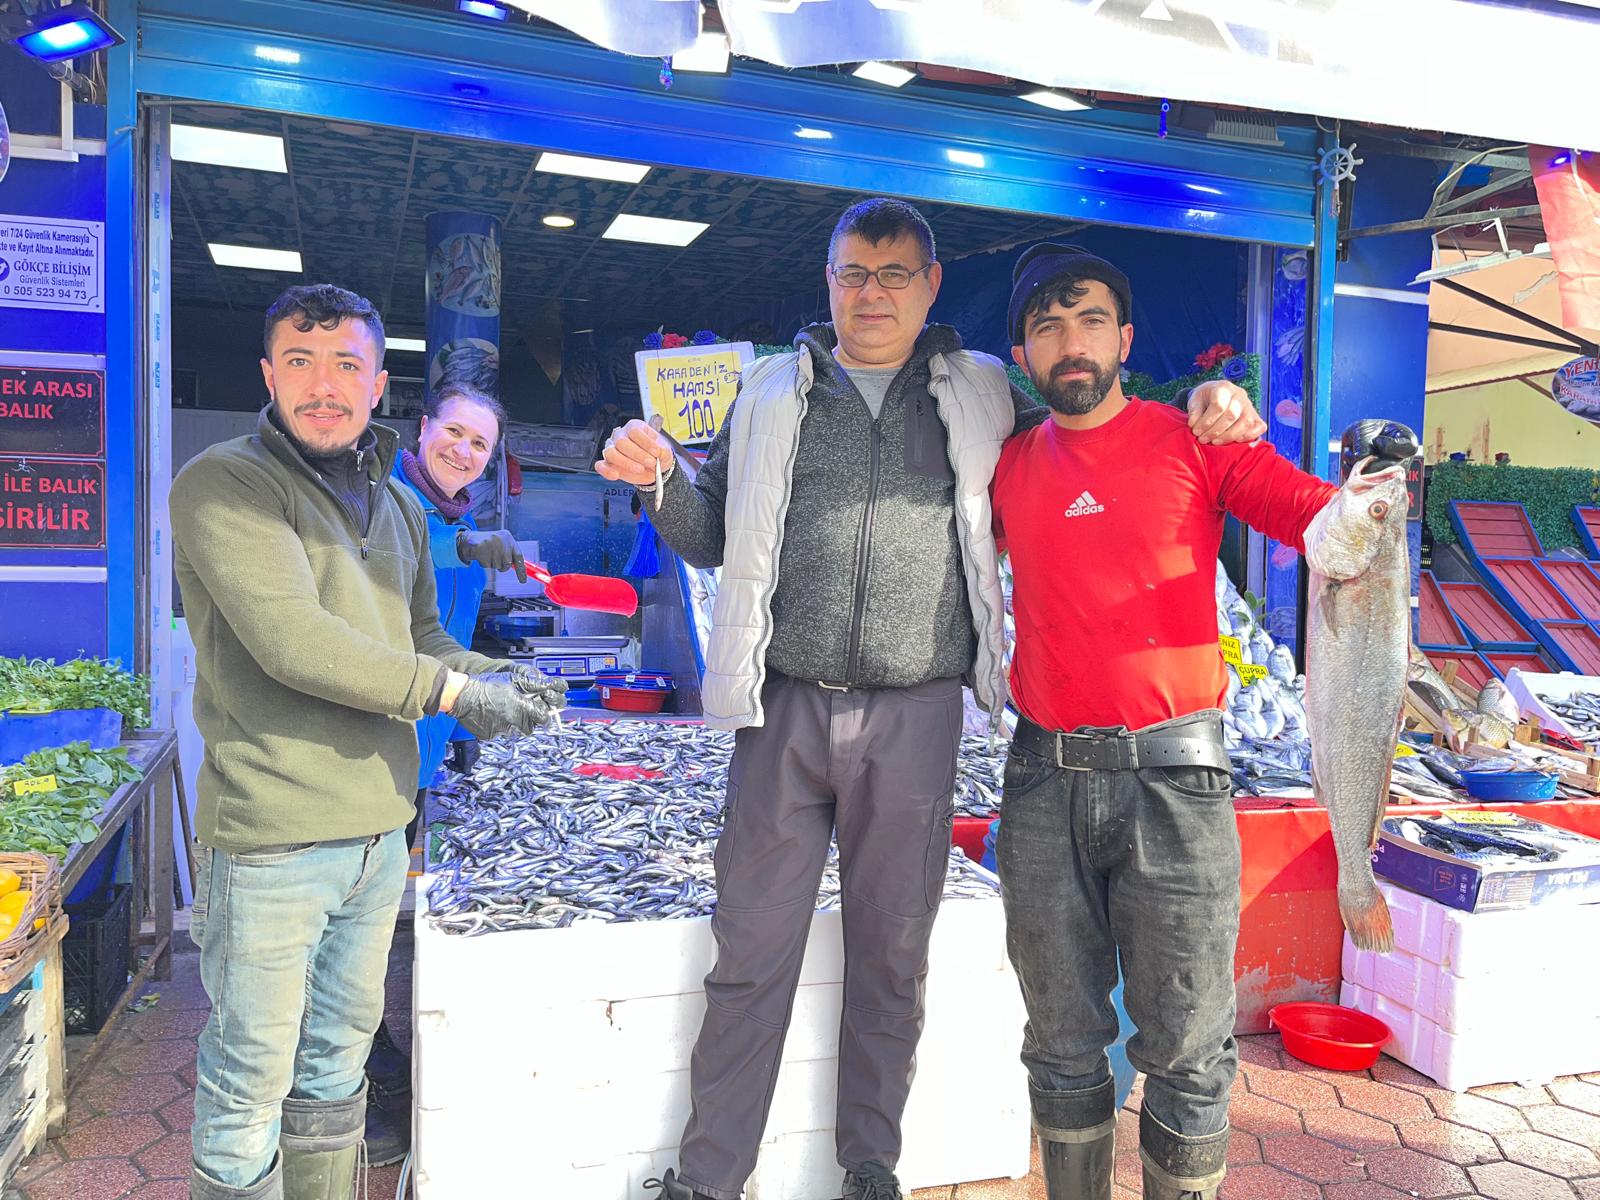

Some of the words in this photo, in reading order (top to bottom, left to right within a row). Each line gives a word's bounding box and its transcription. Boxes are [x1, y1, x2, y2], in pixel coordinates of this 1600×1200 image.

[25, 229, 51, 241] Güvenlik
[18, 242, 34, 254] Kayıt
[14, 258, 50, 275] GÖKÇE
[52, 261, 91, 278] BİLİŞİM
[20, 274, 50, 286] Güvenlik
[51, 277, 86, 288] Sistemleri
[4, 285, 11, 295] 0
[13, 286, 33, 296] 505
[36, 287, 55, 298] 523
[58, 289, 71, 299] 94
[74, 290, 87, 300] 73
[32, 380, 93, 399] ARASI
[0, 402, 54, 419] BALIK
[678, 399, 715, 439] 100
[4, 472, 32, 493] İLE
[39, 477, 97, 495] BALIK
[1064, 504, 1105, 518] adidas
